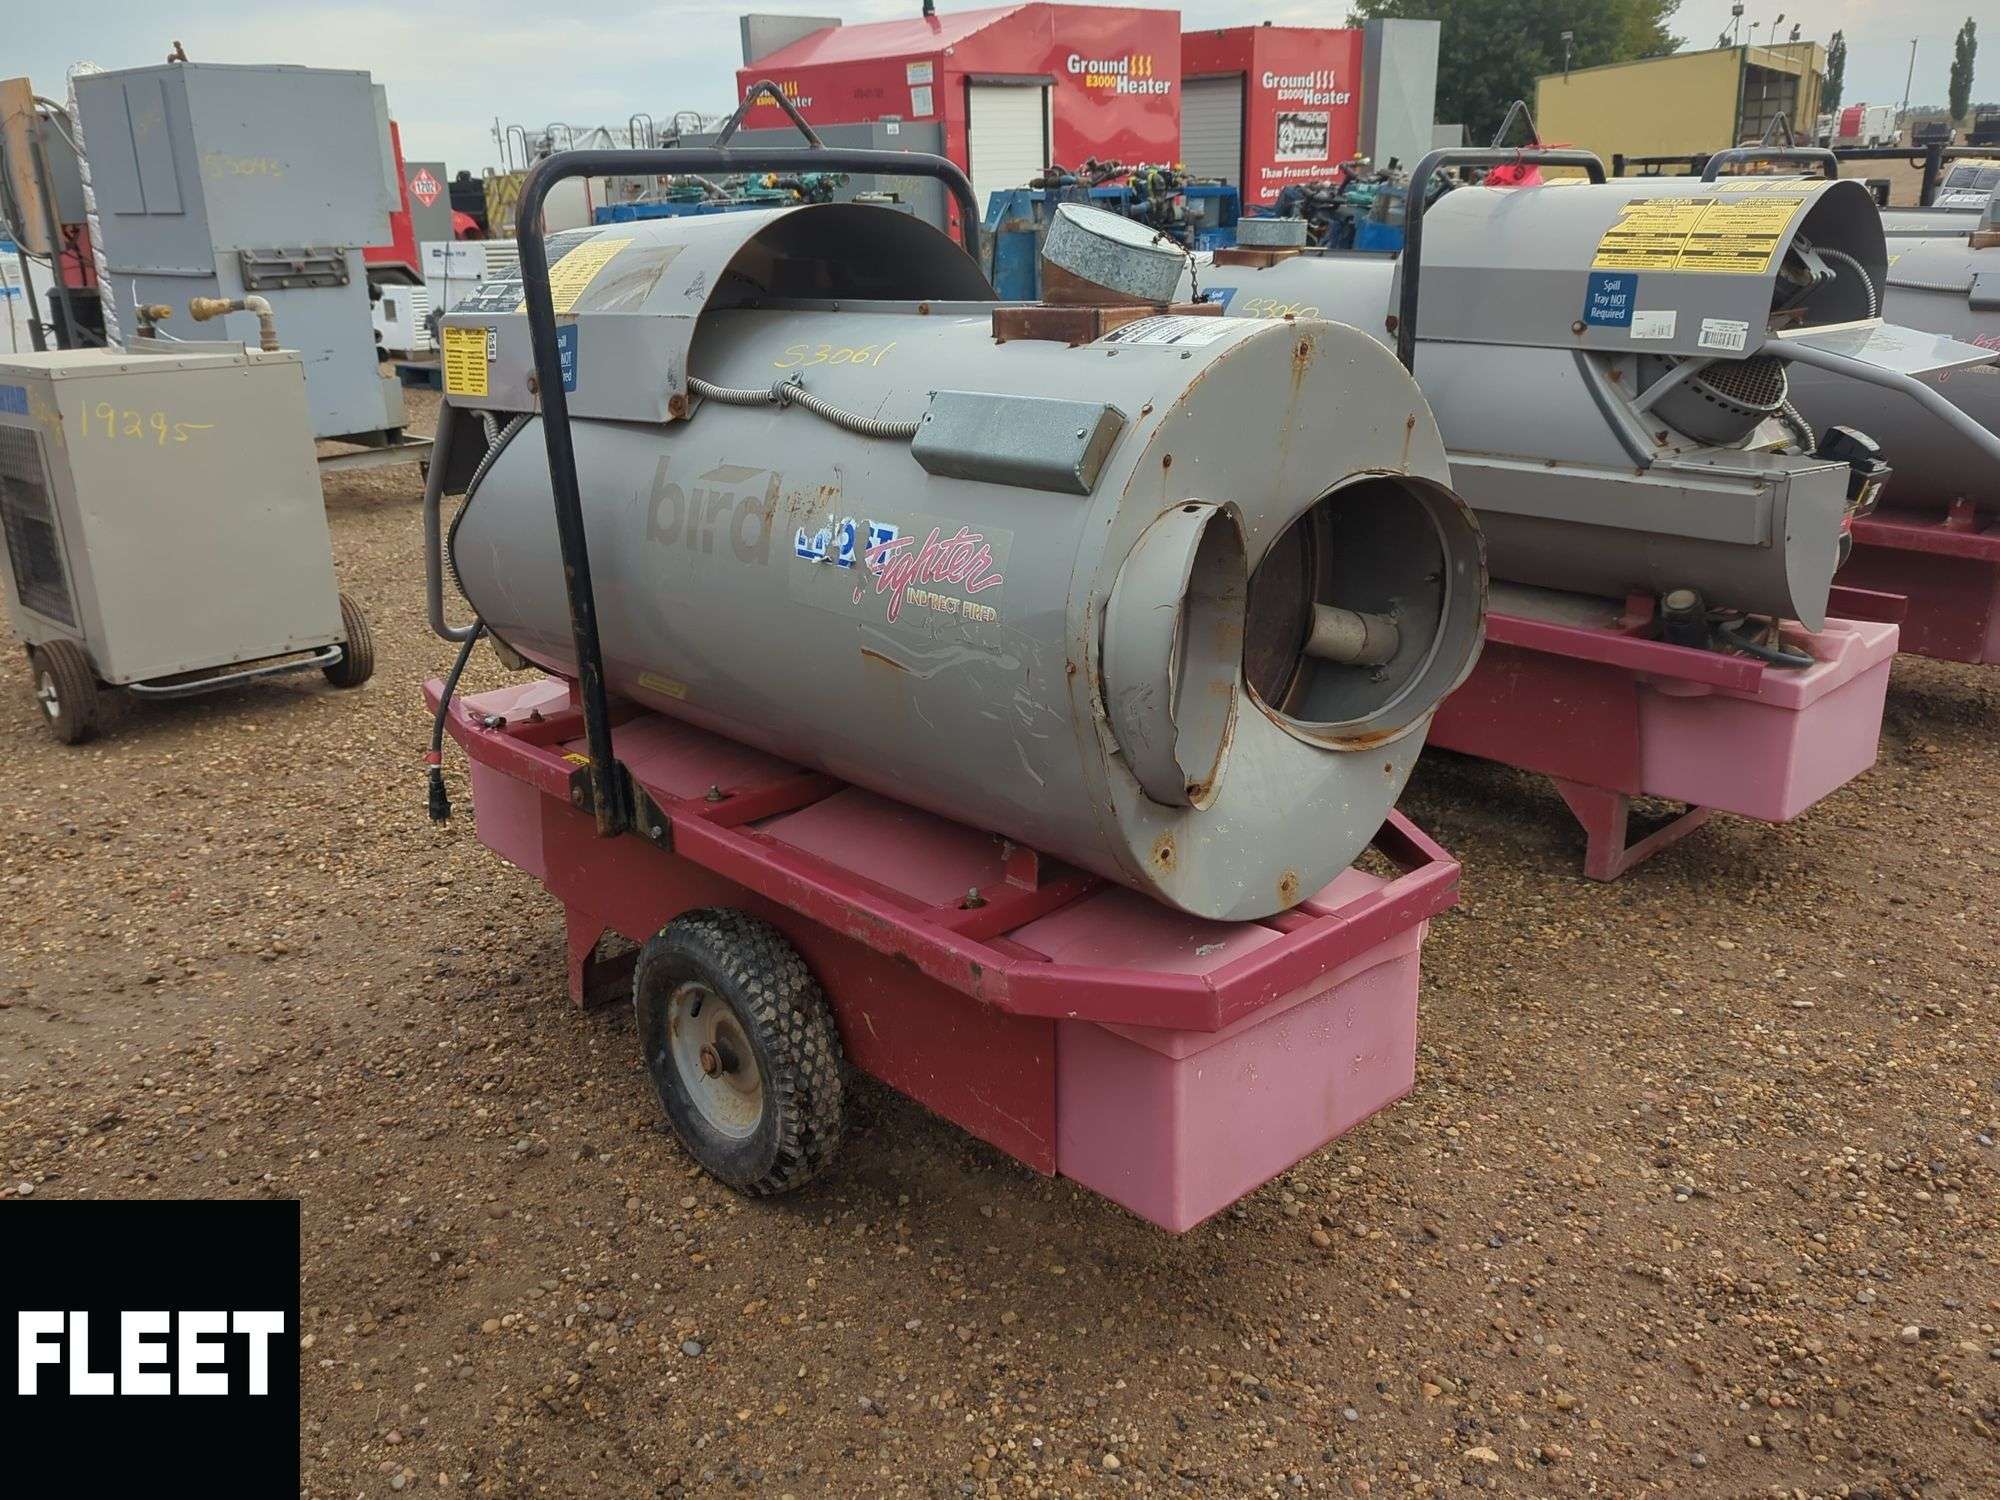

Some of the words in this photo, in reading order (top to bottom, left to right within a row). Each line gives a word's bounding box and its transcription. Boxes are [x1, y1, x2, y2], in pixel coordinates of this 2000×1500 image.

[1067, 54, 1129, 74] Ground
[1116, 75, 1171, 94] Heater
[1262, 71, 1314, 88] Ground
[1303, 88, 1350, 106] Heater
[1311, 164, 1339, 176] Ground
[1604, 279, 1621, 292] Spill
[1593, 293, 1609, 306] Tray
[1610, 294, 1627, 307] NOT
[1590, 307, 1626, 321] Required
[773, 342, 897, 368] S3061
[80, 400, 215, 445] 19295
[864, 525, 1003, 624] Fighter
